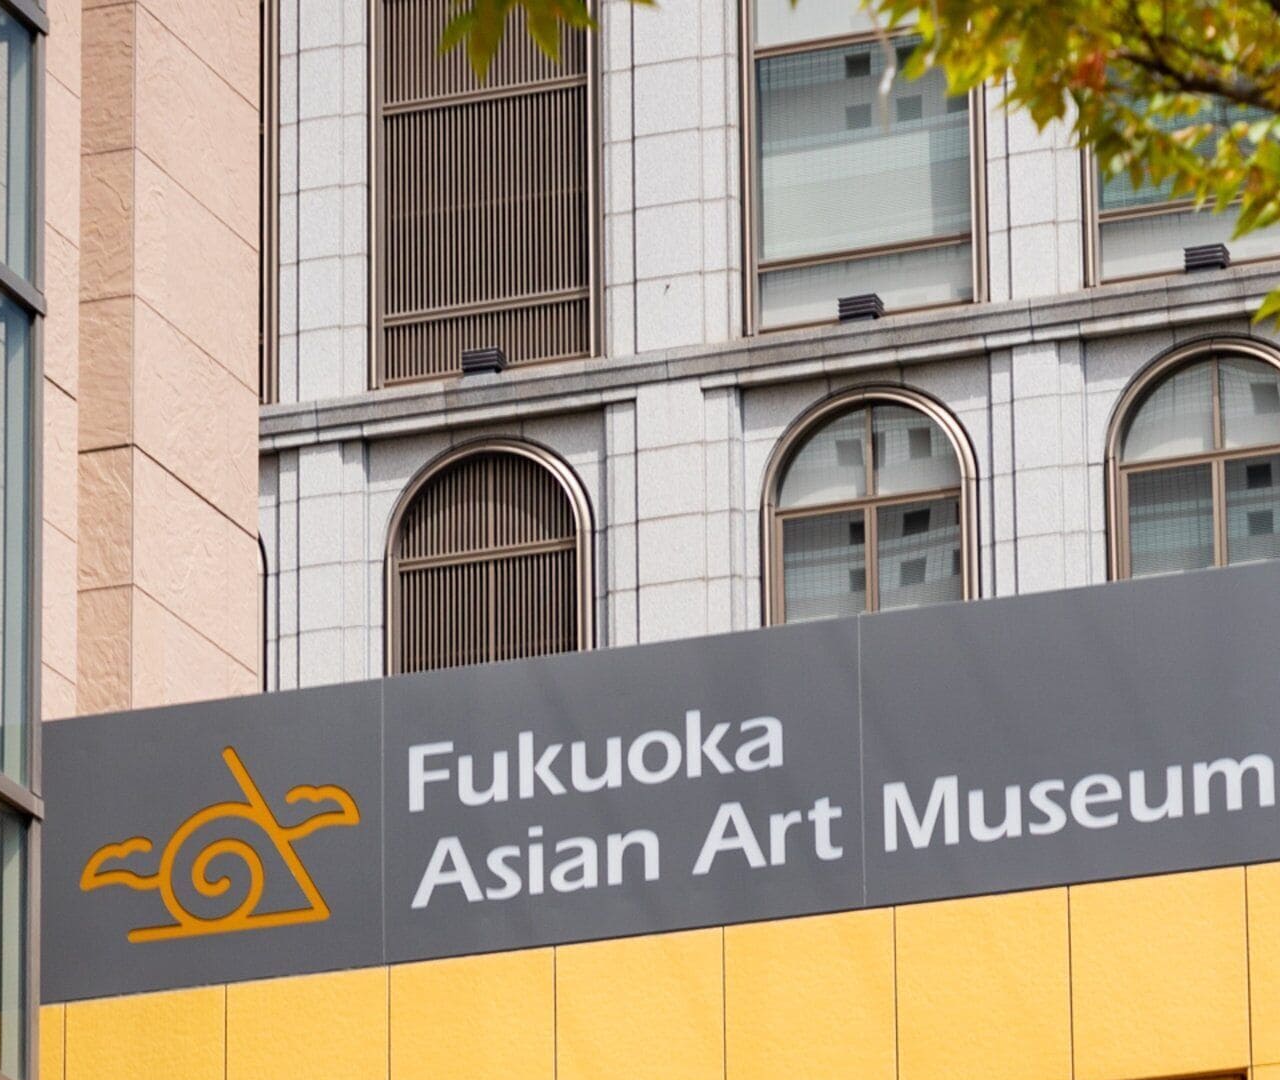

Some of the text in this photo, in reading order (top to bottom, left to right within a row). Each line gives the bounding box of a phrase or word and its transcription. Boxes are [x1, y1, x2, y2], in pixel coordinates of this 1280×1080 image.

[407, 708, 785, 813] Fukuoka
[410, 753, 1277, 910] Asian Art Museum
